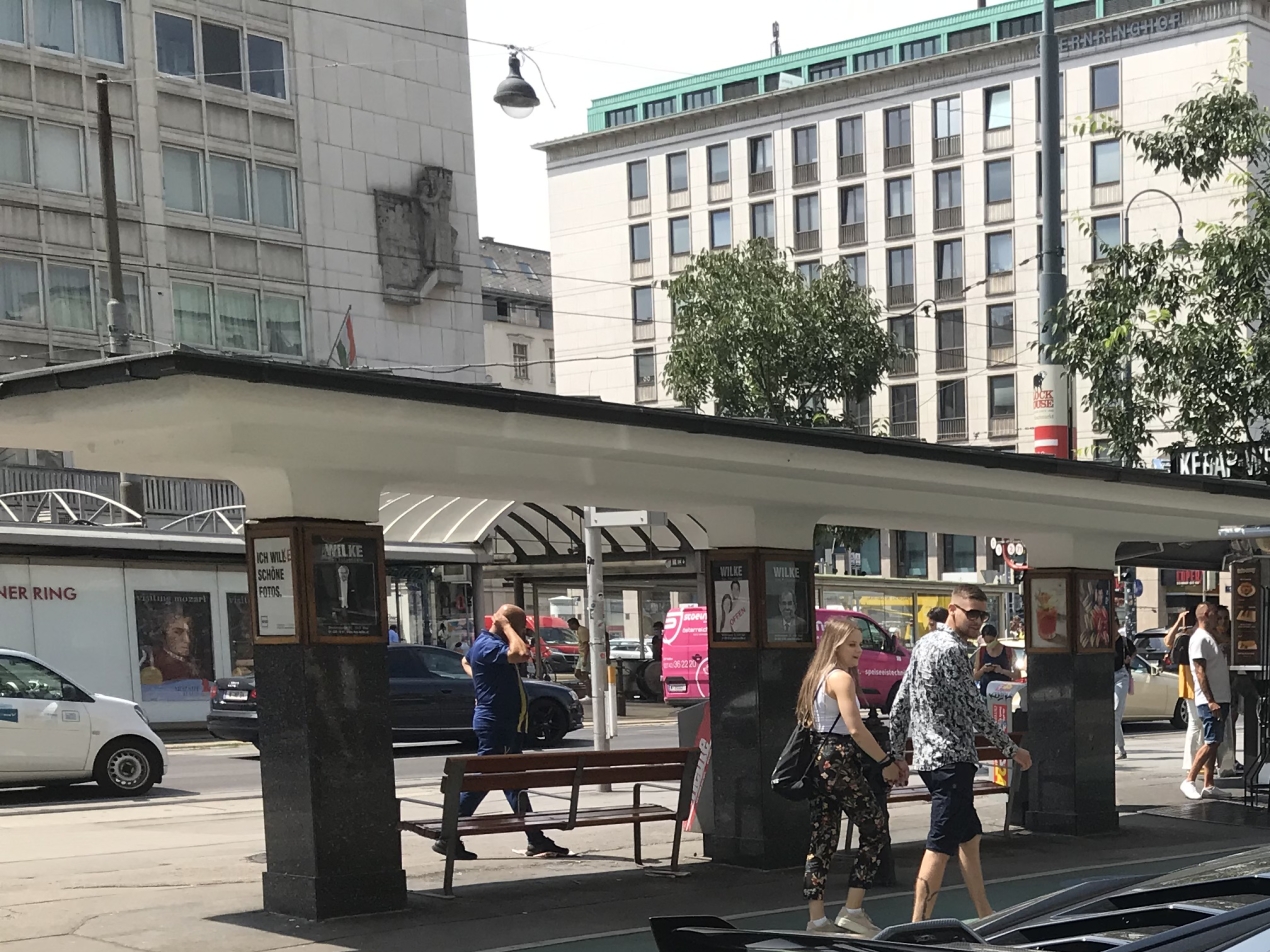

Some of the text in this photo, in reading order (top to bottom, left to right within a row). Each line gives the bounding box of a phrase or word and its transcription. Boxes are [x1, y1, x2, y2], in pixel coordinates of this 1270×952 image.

[1035, 11, 1180, 57] OERNRINGHOF
[257, 551, 269, 564] ICH
[322, 543, 364, 558] WILKE
[257, 565, 285, 581] SCHÖNE
[720, 565, 743, 577] WILKE
[773, 566, 800, 578] WILKE
[33, 586, 77, 601] RING
[174, 594, 207, 603] mozart
[258, 585, 283, 598] FOTOS.
[729, 607, 747, 627] OFFEN
